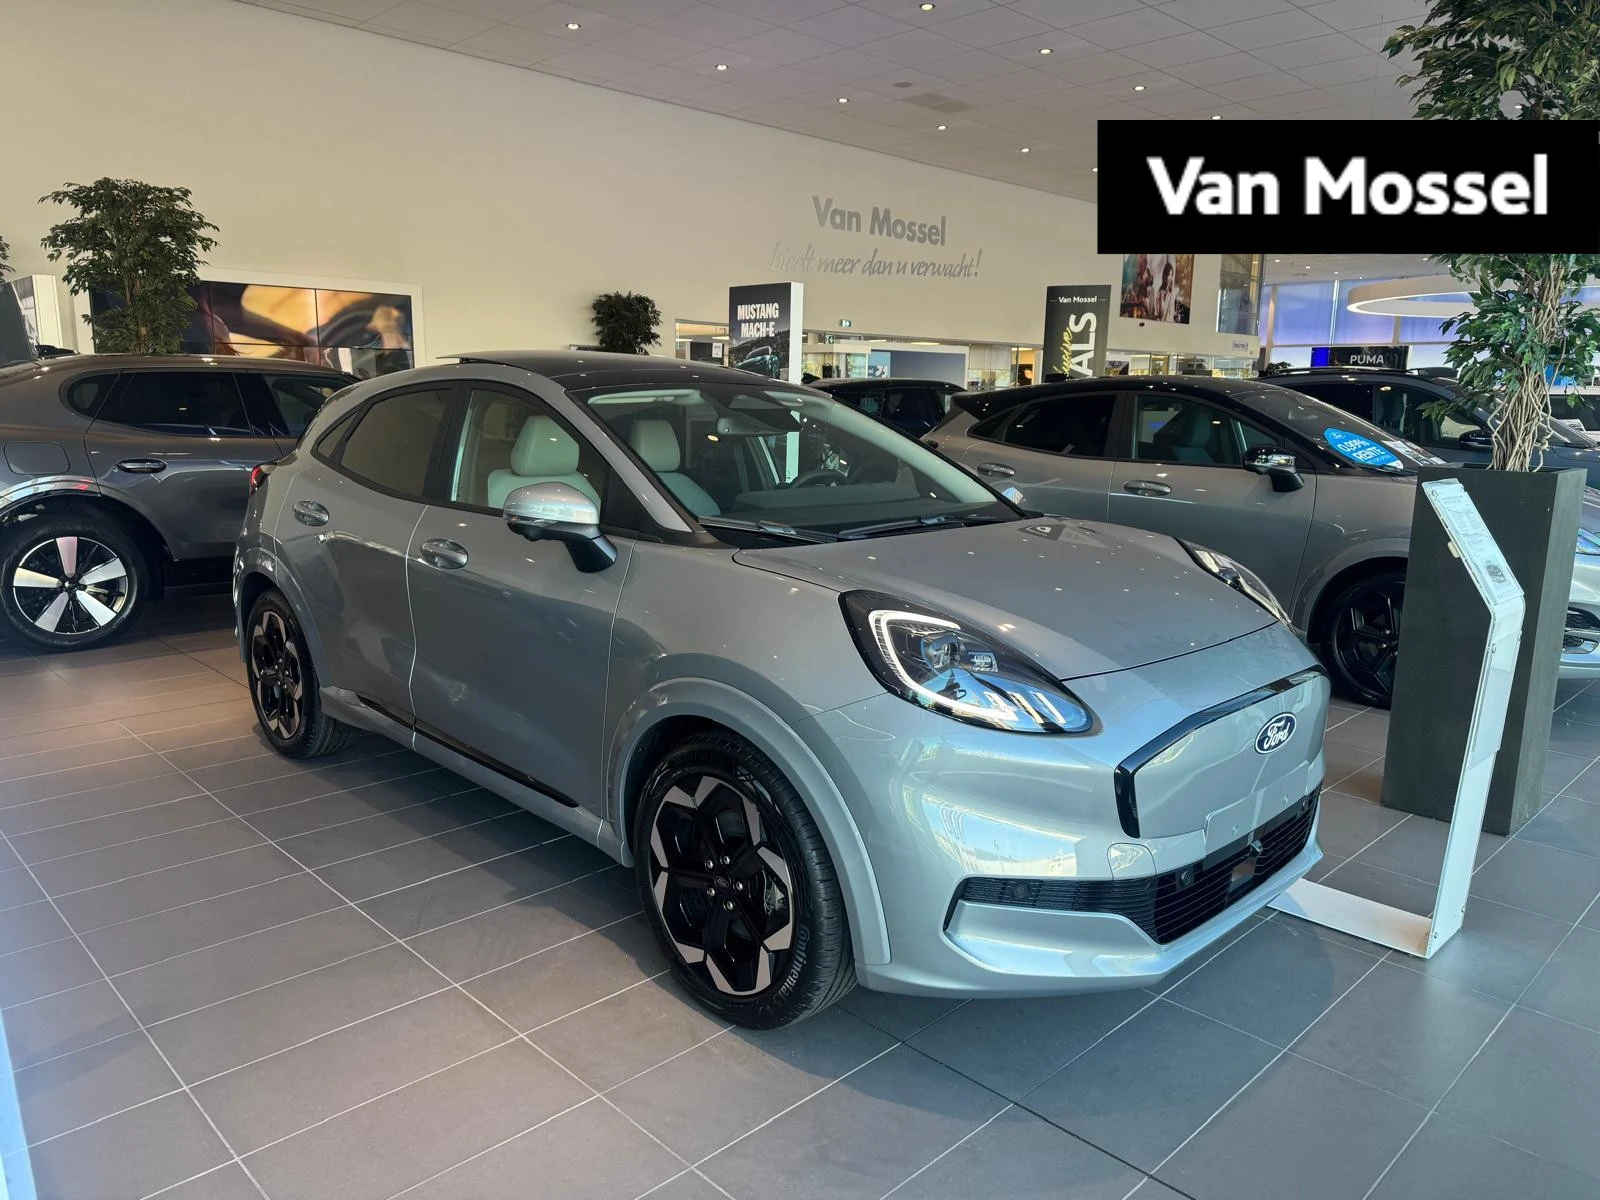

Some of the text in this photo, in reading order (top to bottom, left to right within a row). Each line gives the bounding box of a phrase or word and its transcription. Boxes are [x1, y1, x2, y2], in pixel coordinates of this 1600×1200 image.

[811, 195, 946, 247] Van Mossel
[817, 255, 862, 274] meer
[862, 248, 893, 276] dan
[896, 261, 908, 275] u
[910, 248, 983, 278] verwacht!
[1059, 295, 1098, 304] Van Mossel
[737, 302, 780, 321] MUSTANG
[741, 321, 775, 339] MACH-E
[1350, 354, 1385, 365] PUMA
[1351, 446, 1386, 462] RENTE
[1263, 720, 1291, 750] Ford
